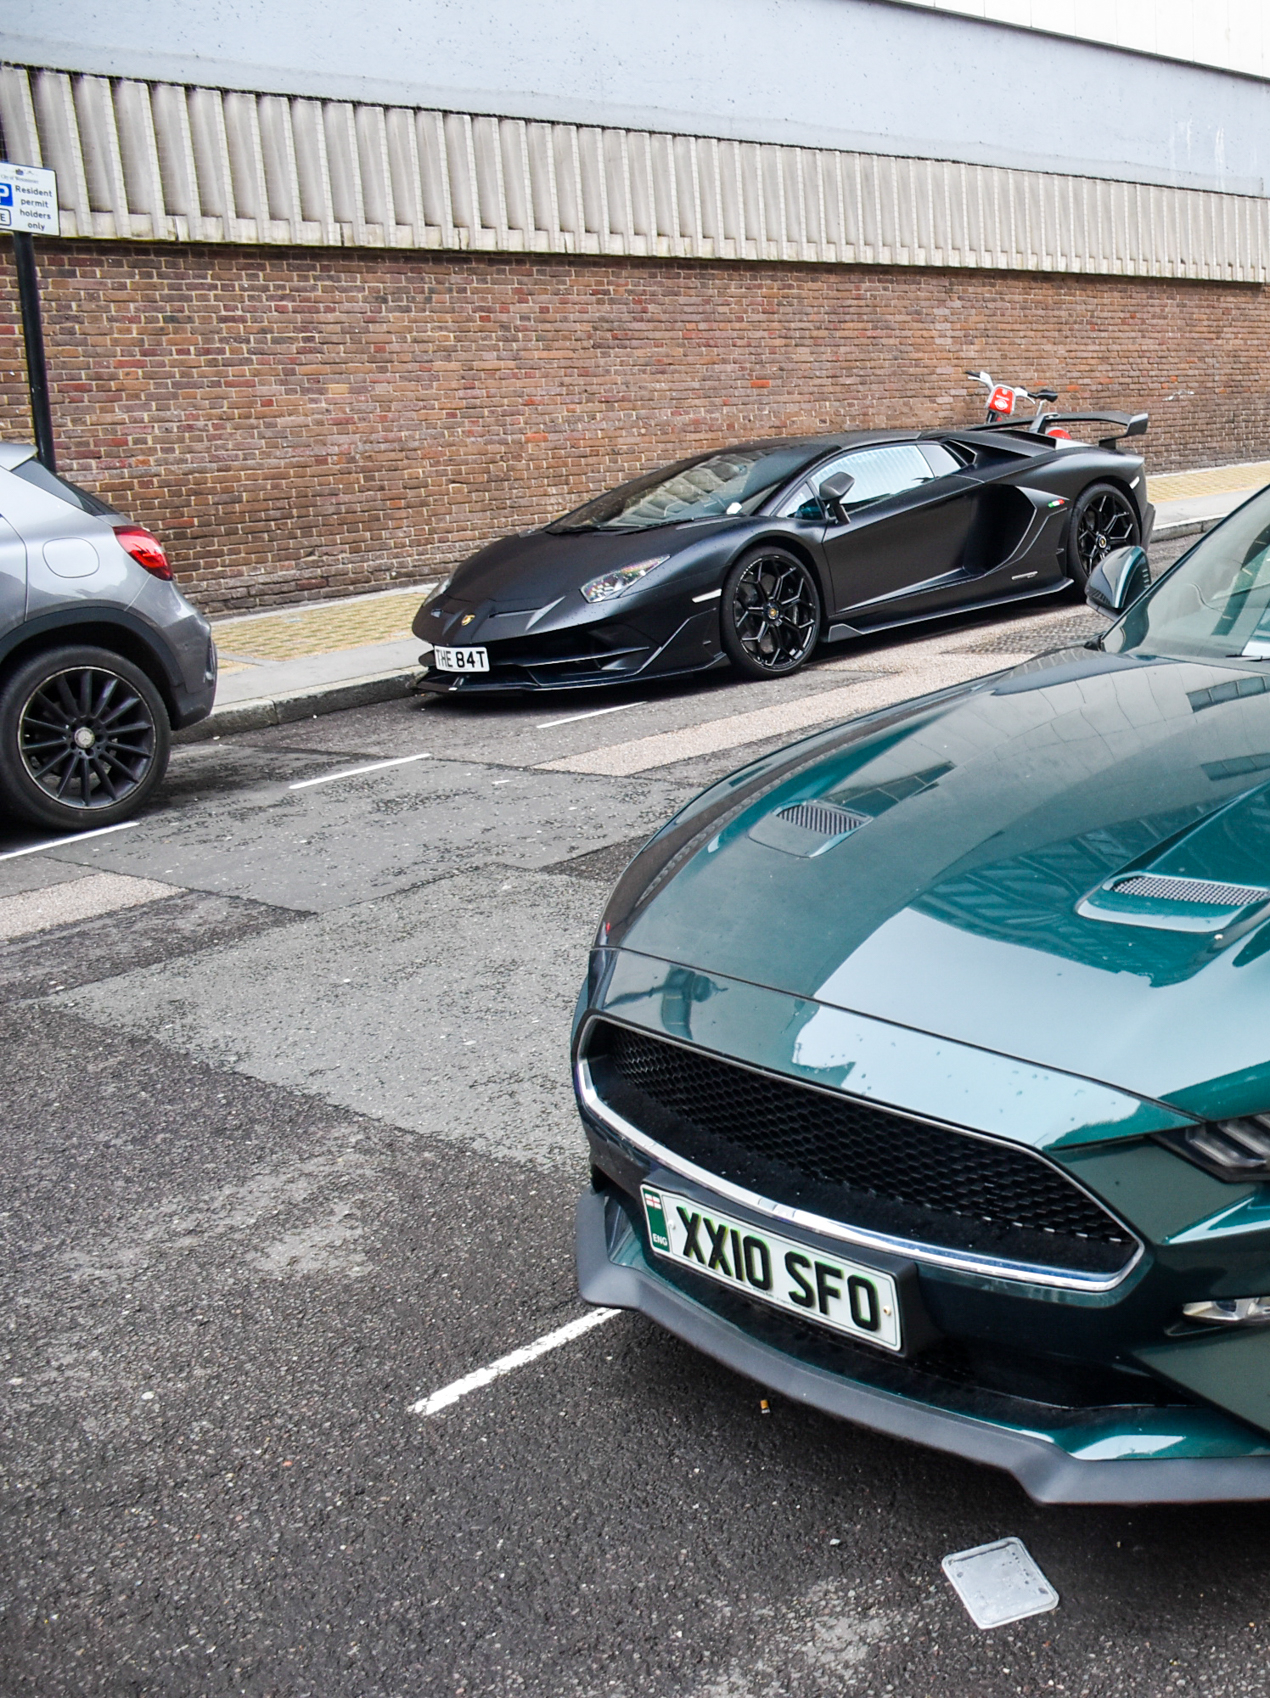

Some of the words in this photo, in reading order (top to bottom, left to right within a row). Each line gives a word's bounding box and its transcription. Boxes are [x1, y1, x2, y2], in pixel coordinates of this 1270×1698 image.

[15, 185, 53, 197] Resident
[21, 199, 49, 209] permit
[20, 208, 52, 220] holders
[27, 222, 46, 232] only
[436, 650, 453, 668] THE
[455, 651, 485, 668] 84T
[652, 1232, 668, 1246] ENG
[676, 1206, 773, 1291] XX10
[784, 1251, 881, 1332] SFO
